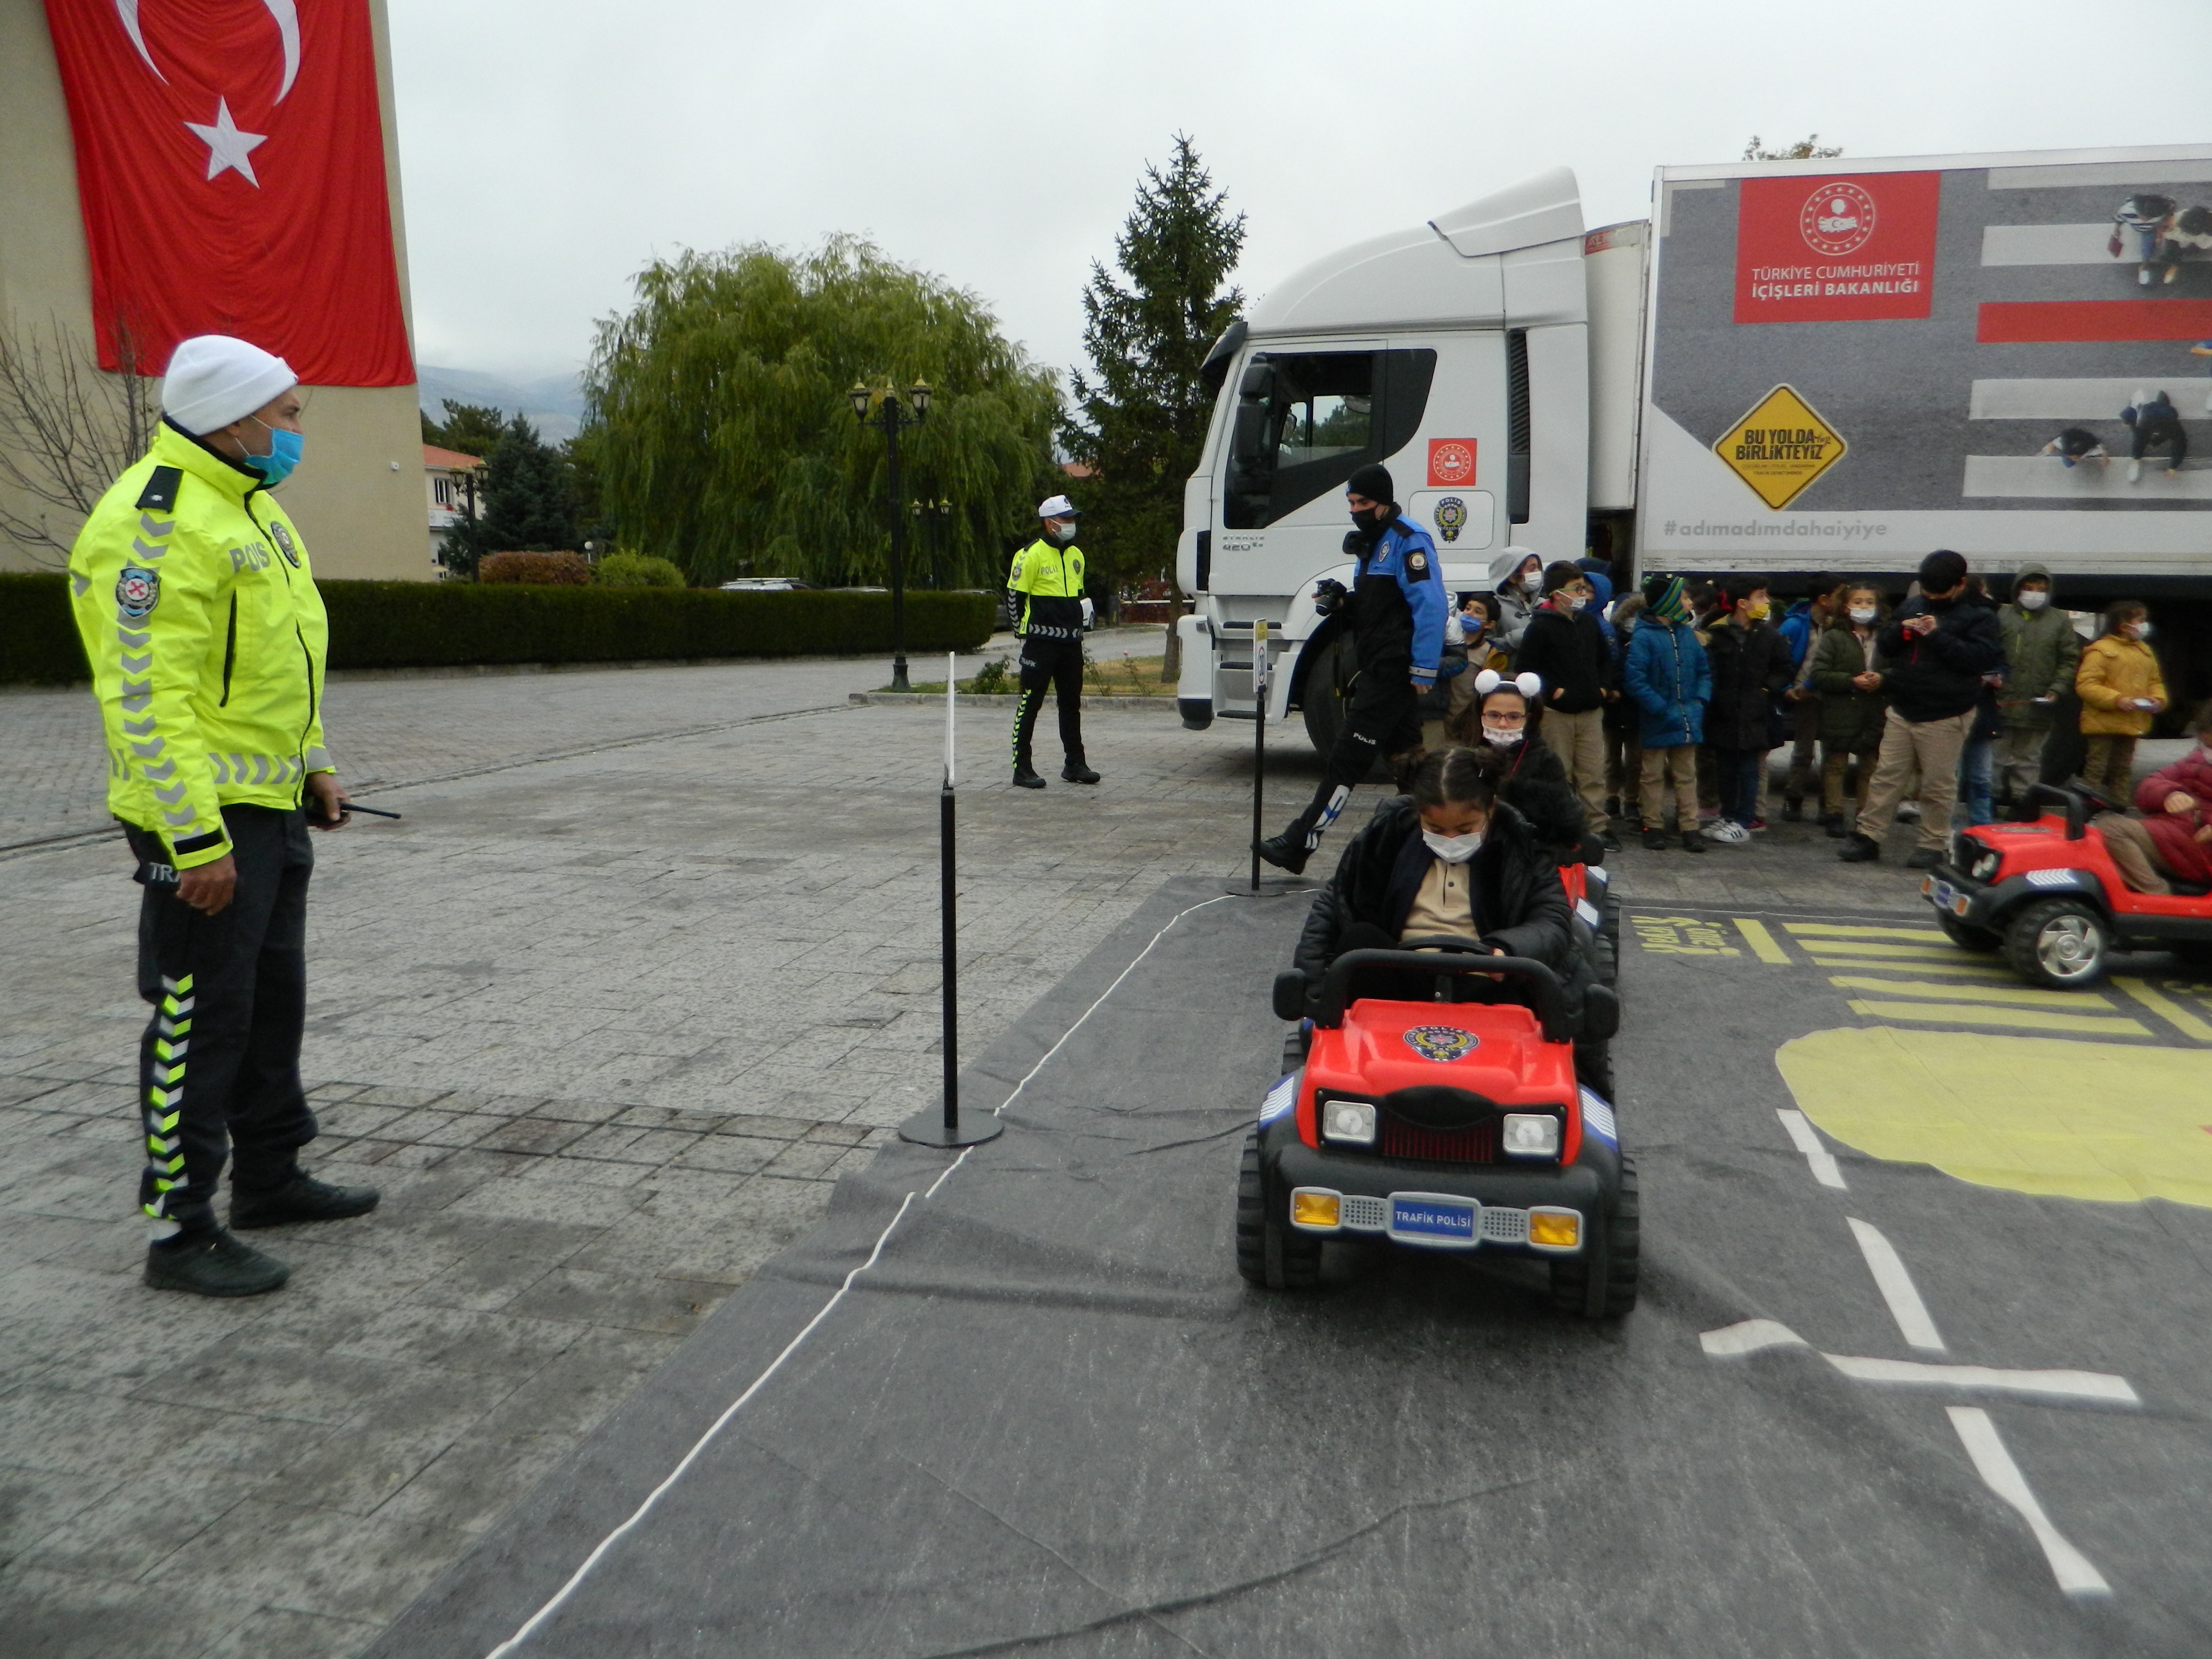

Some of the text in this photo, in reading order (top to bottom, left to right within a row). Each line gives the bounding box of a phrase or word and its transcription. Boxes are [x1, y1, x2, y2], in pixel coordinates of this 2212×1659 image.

[1752, 261, 1919, 281] TÜRKİYE CUMHURİYETİ
[1752, 279, 1919, 301] İÇİŞLERİ BAKANLIĞI
[1745, 429, 1815, 444] BU YOLDA
[1664, 520, 1887, 540] #adımadımdahaiyiye
[1395, 1210, 1471, 1227] TRAFİK POLİSİ
